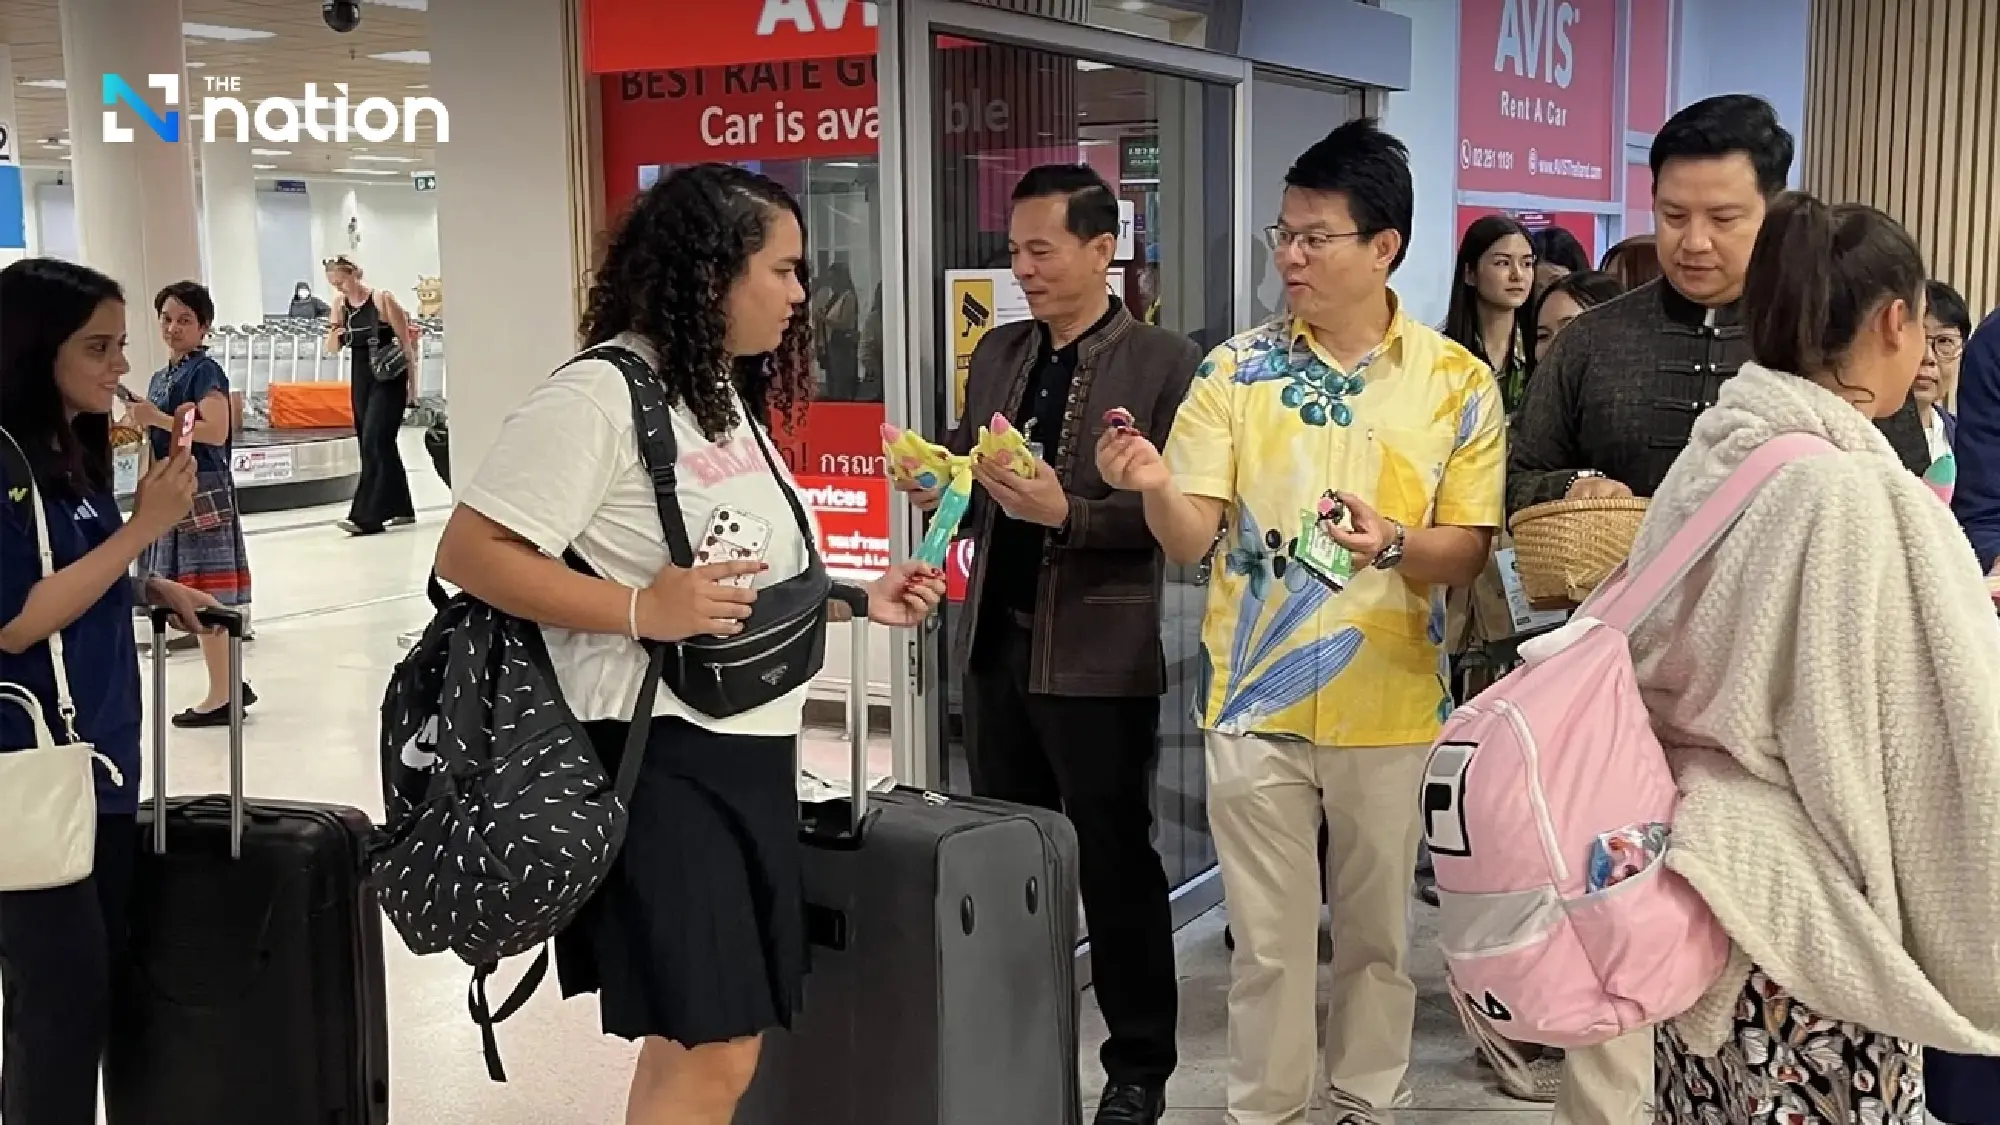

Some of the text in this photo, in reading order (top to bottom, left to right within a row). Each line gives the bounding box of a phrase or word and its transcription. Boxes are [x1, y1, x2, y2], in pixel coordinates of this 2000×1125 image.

[1494, 0, 1573, 89] AVIS
[621, 70, 703, 101] BEST
[725, 59, 822, 95] RATE
[701, 105, 763, 146] Car
[775, 101, 805, 143] is
[1501, 90, 1567, 126] Rent A Car
